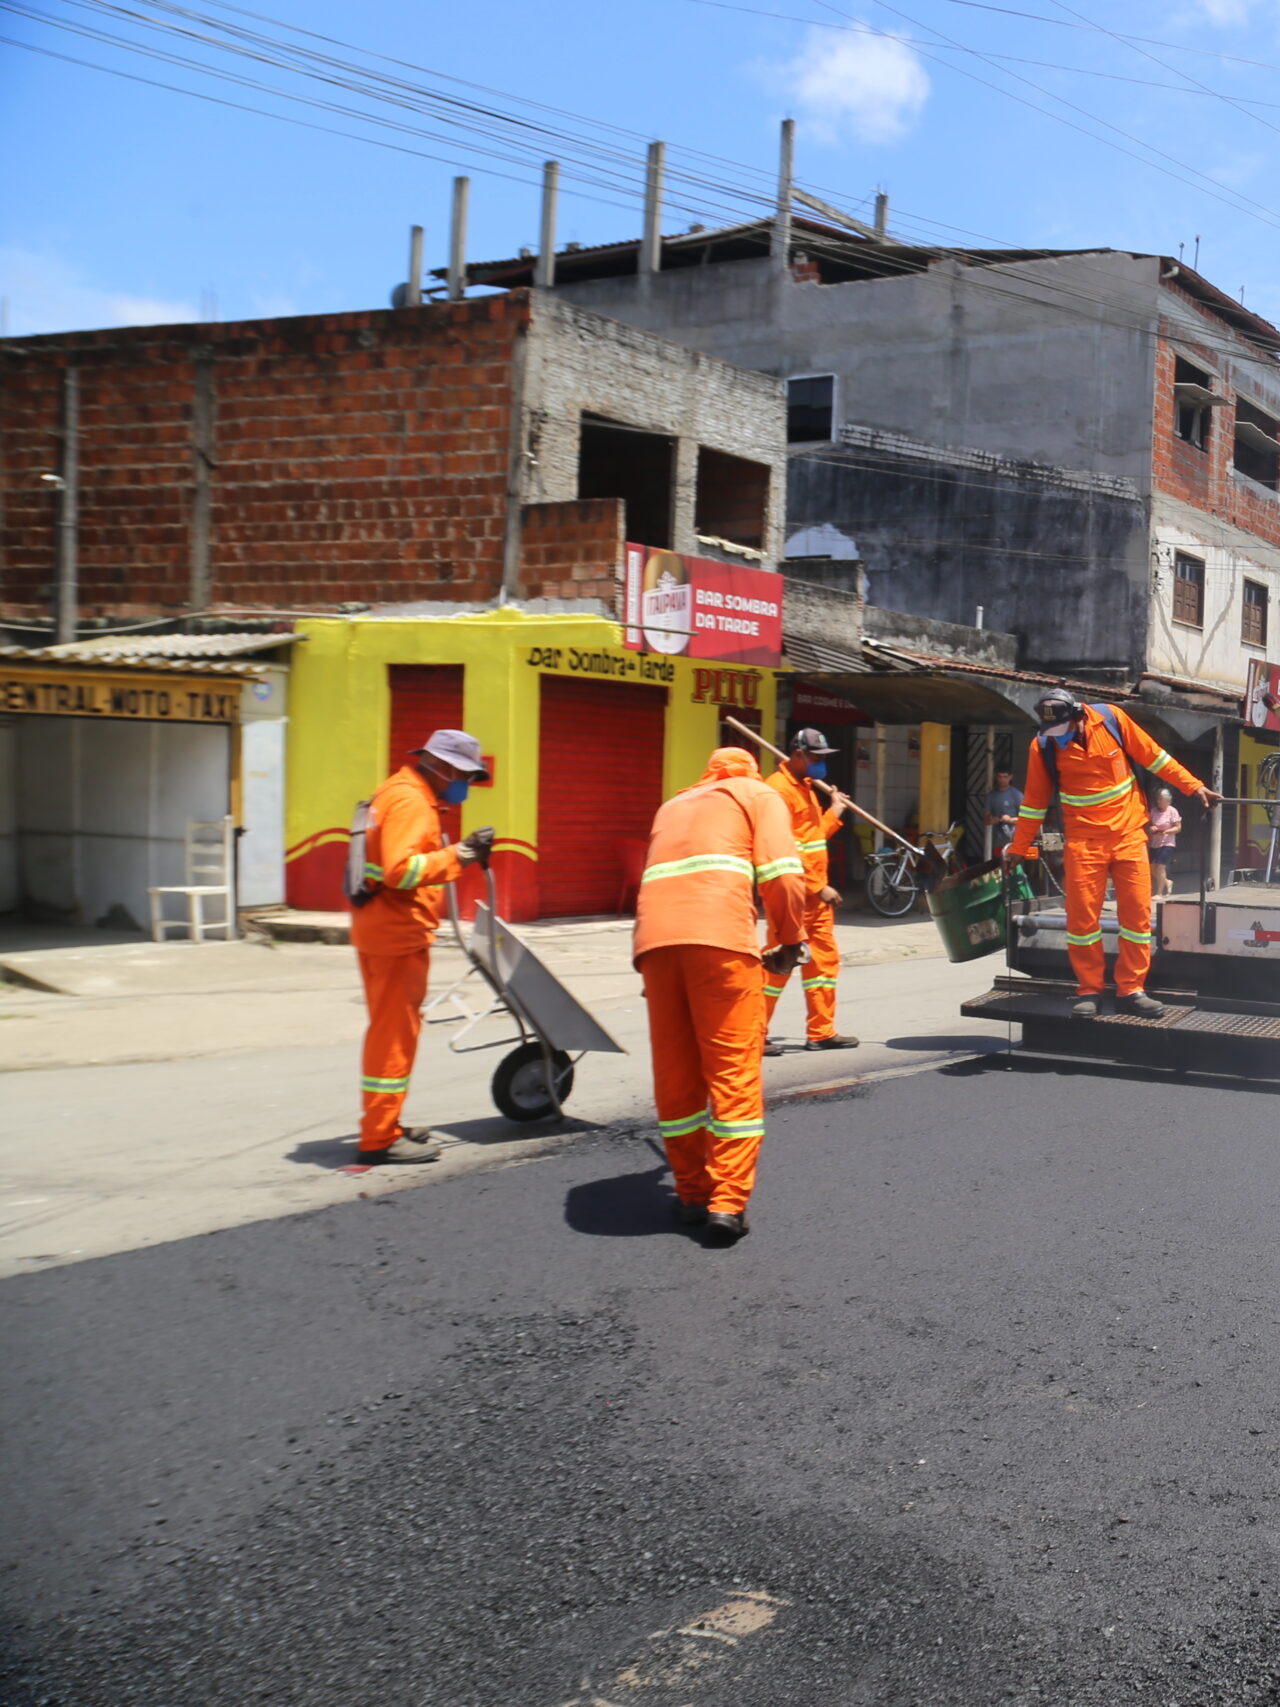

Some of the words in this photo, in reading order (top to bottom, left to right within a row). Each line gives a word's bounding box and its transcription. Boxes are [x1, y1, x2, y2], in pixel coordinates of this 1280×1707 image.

[695, 588, 723, 608] BAR
[724, 594, 778, 618] SOMBRA
[695, 612, 716, 629] DA
[717, 615, 760, 637] TARDE
[568, 647, 626, 676] Sombra
[637, 651, 675, 682] Tarde
[110, 687, 171, 716] MOTO
